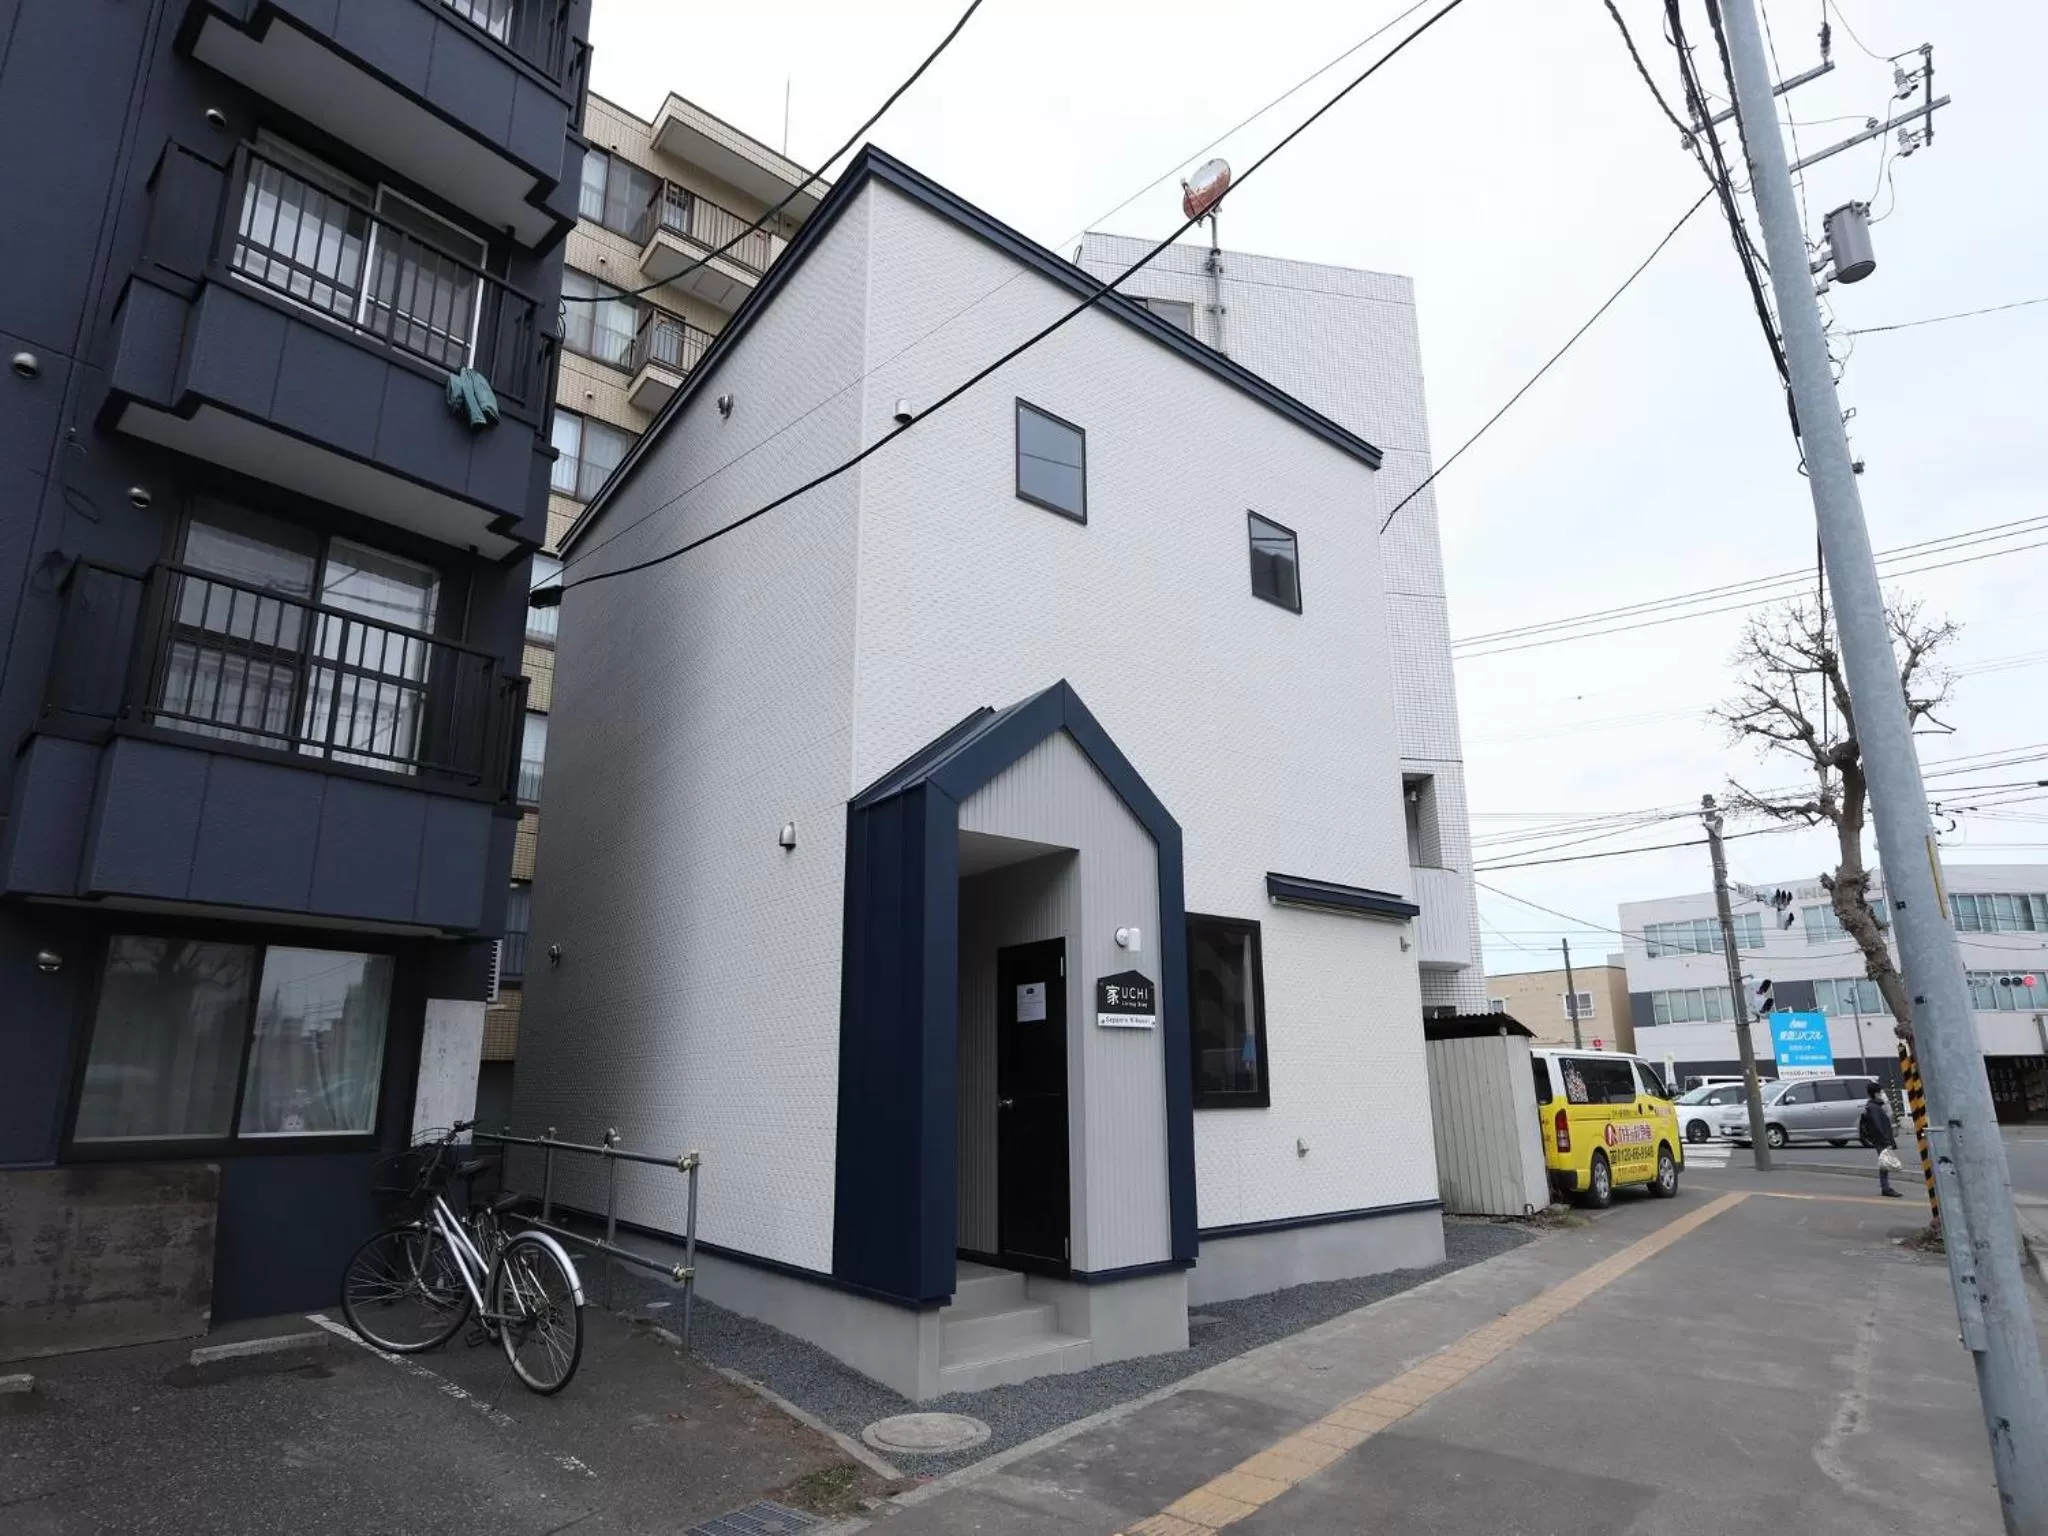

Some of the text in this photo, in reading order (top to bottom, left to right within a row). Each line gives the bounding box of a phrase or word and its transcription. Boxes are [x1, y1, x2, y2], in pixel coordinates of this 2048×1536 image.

[1105, 984, 1120, 1005] 家
[1121, 987, 1148, 1000] UCHI
[1105, 1015, 1129, 1024] Sapporo
